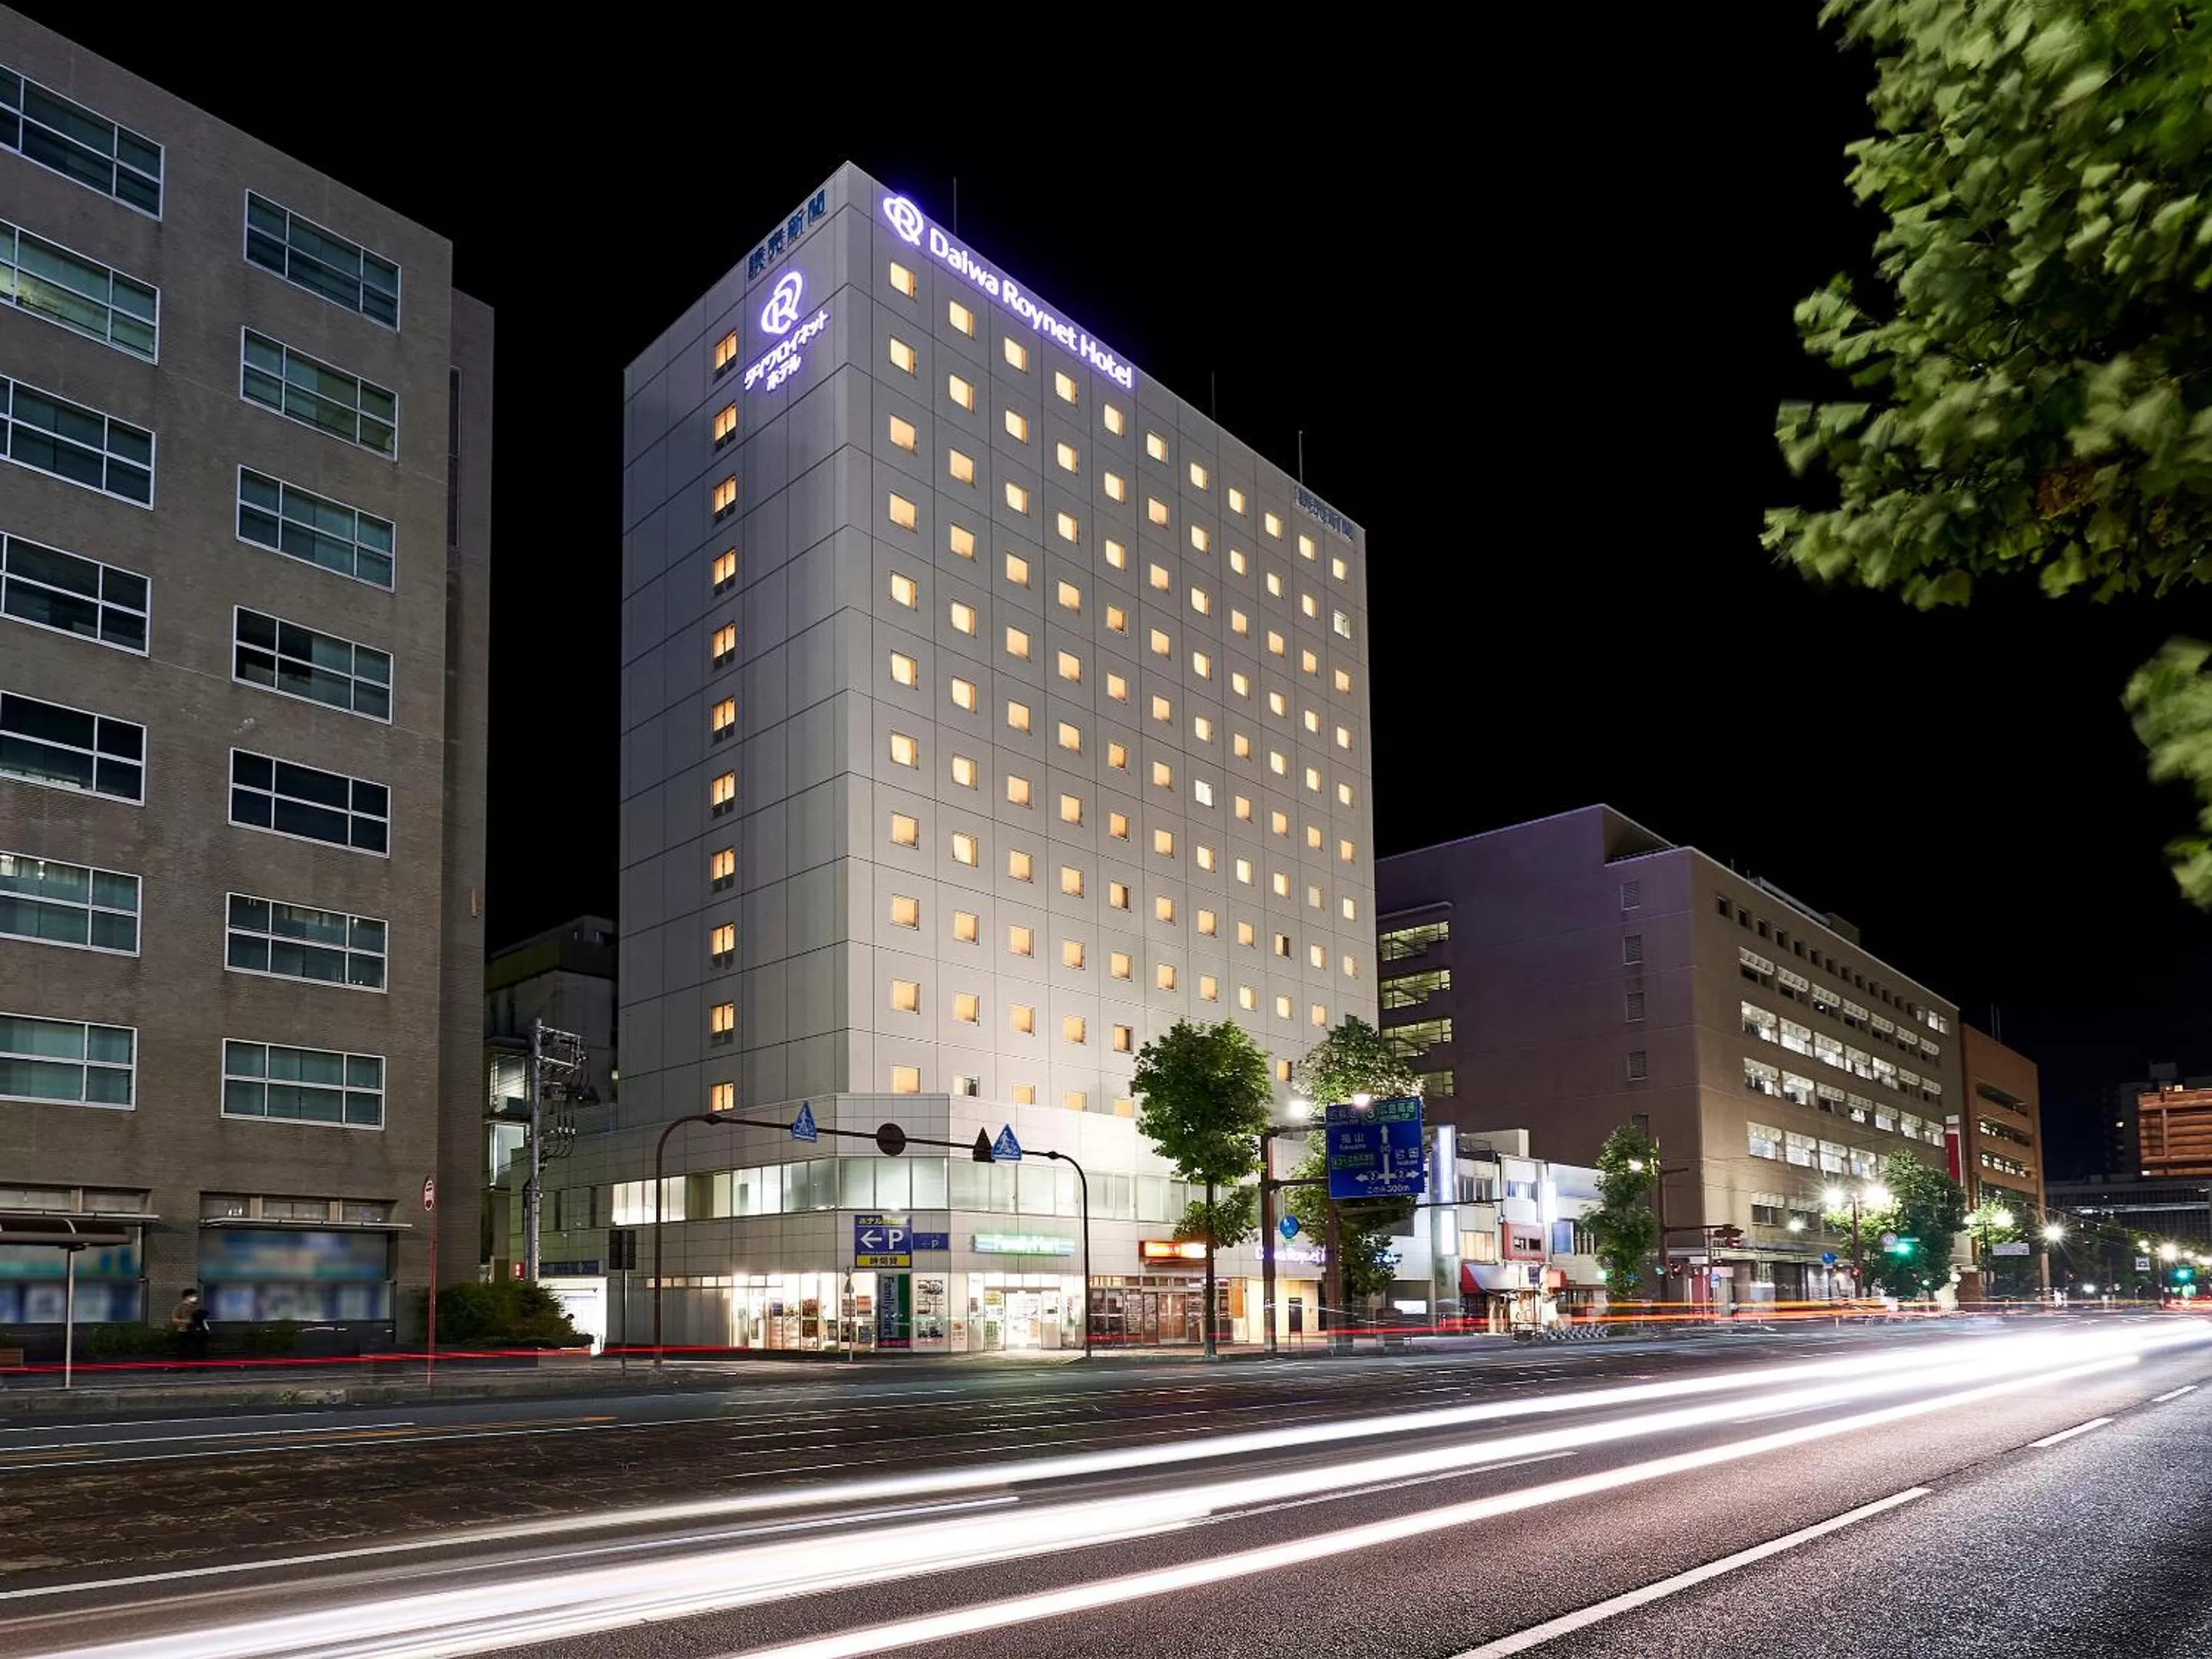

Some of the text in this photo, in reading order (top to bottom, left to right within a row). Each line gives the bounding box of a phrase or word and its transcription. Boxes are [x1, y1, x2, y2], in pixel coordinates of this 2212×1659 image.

[929, 227, 1132, 389] Daiwa Roynet Hotel
[743, 309, 830, 390] ダイワロイネット
[766, 353, 802, 392] ホテル
[889, 1229, 904, 1250] P
[932, 1240, 939, 1248] P
